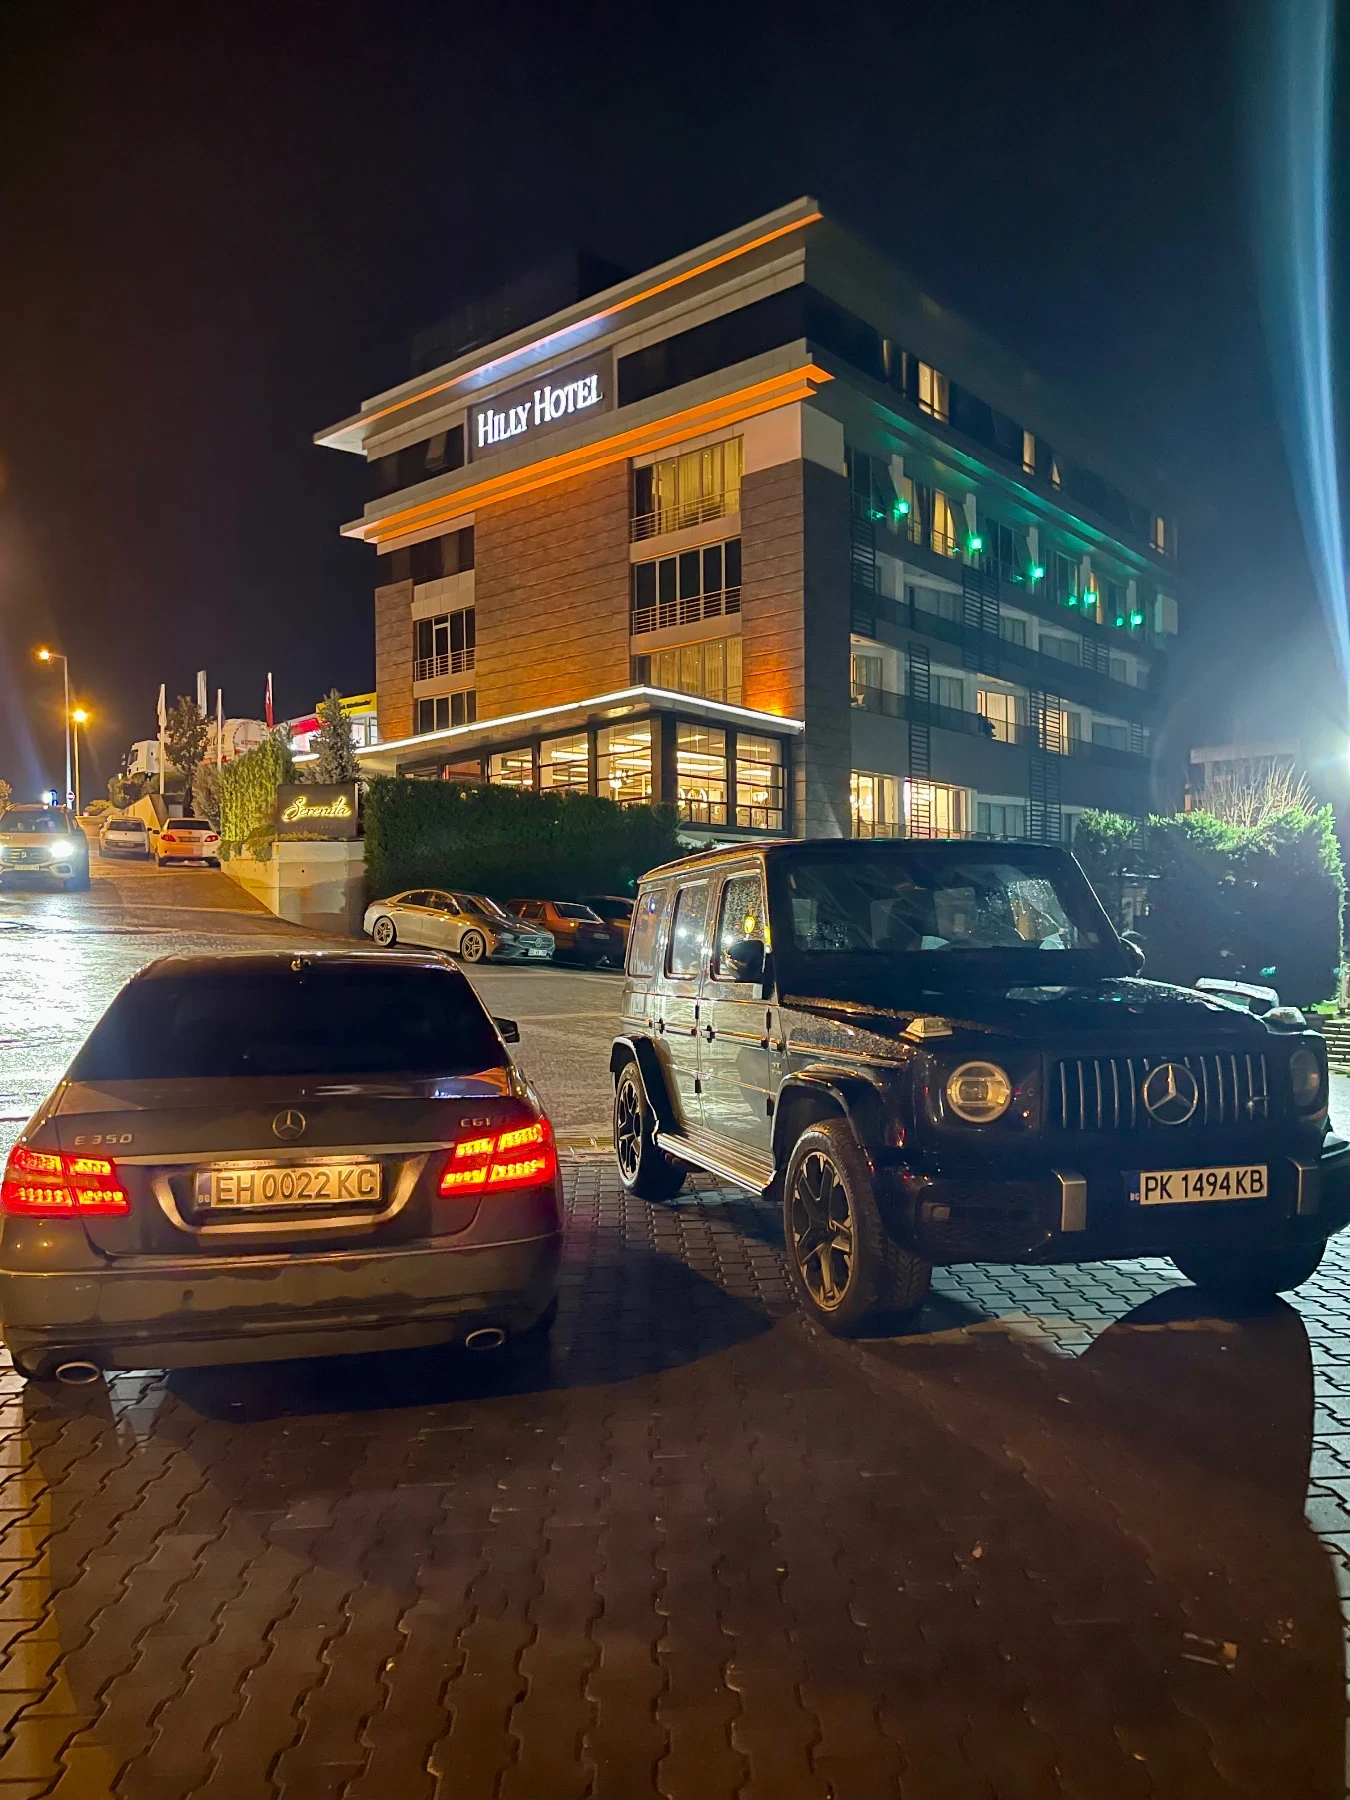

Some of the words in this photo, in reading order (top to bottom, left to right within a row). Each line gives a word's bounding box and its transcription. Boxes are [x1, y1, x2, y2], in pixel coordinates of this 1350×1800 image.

[477, 402, 532, 447] HILLY
[533, 374, 603, 425] HOTEL
[460, 1117, 491, 1127] CGI
[74, 1135, 86, 1145] E
[92, 1133, 133, 1145] 350
[1144, 1174, 1173, 1201] PK
